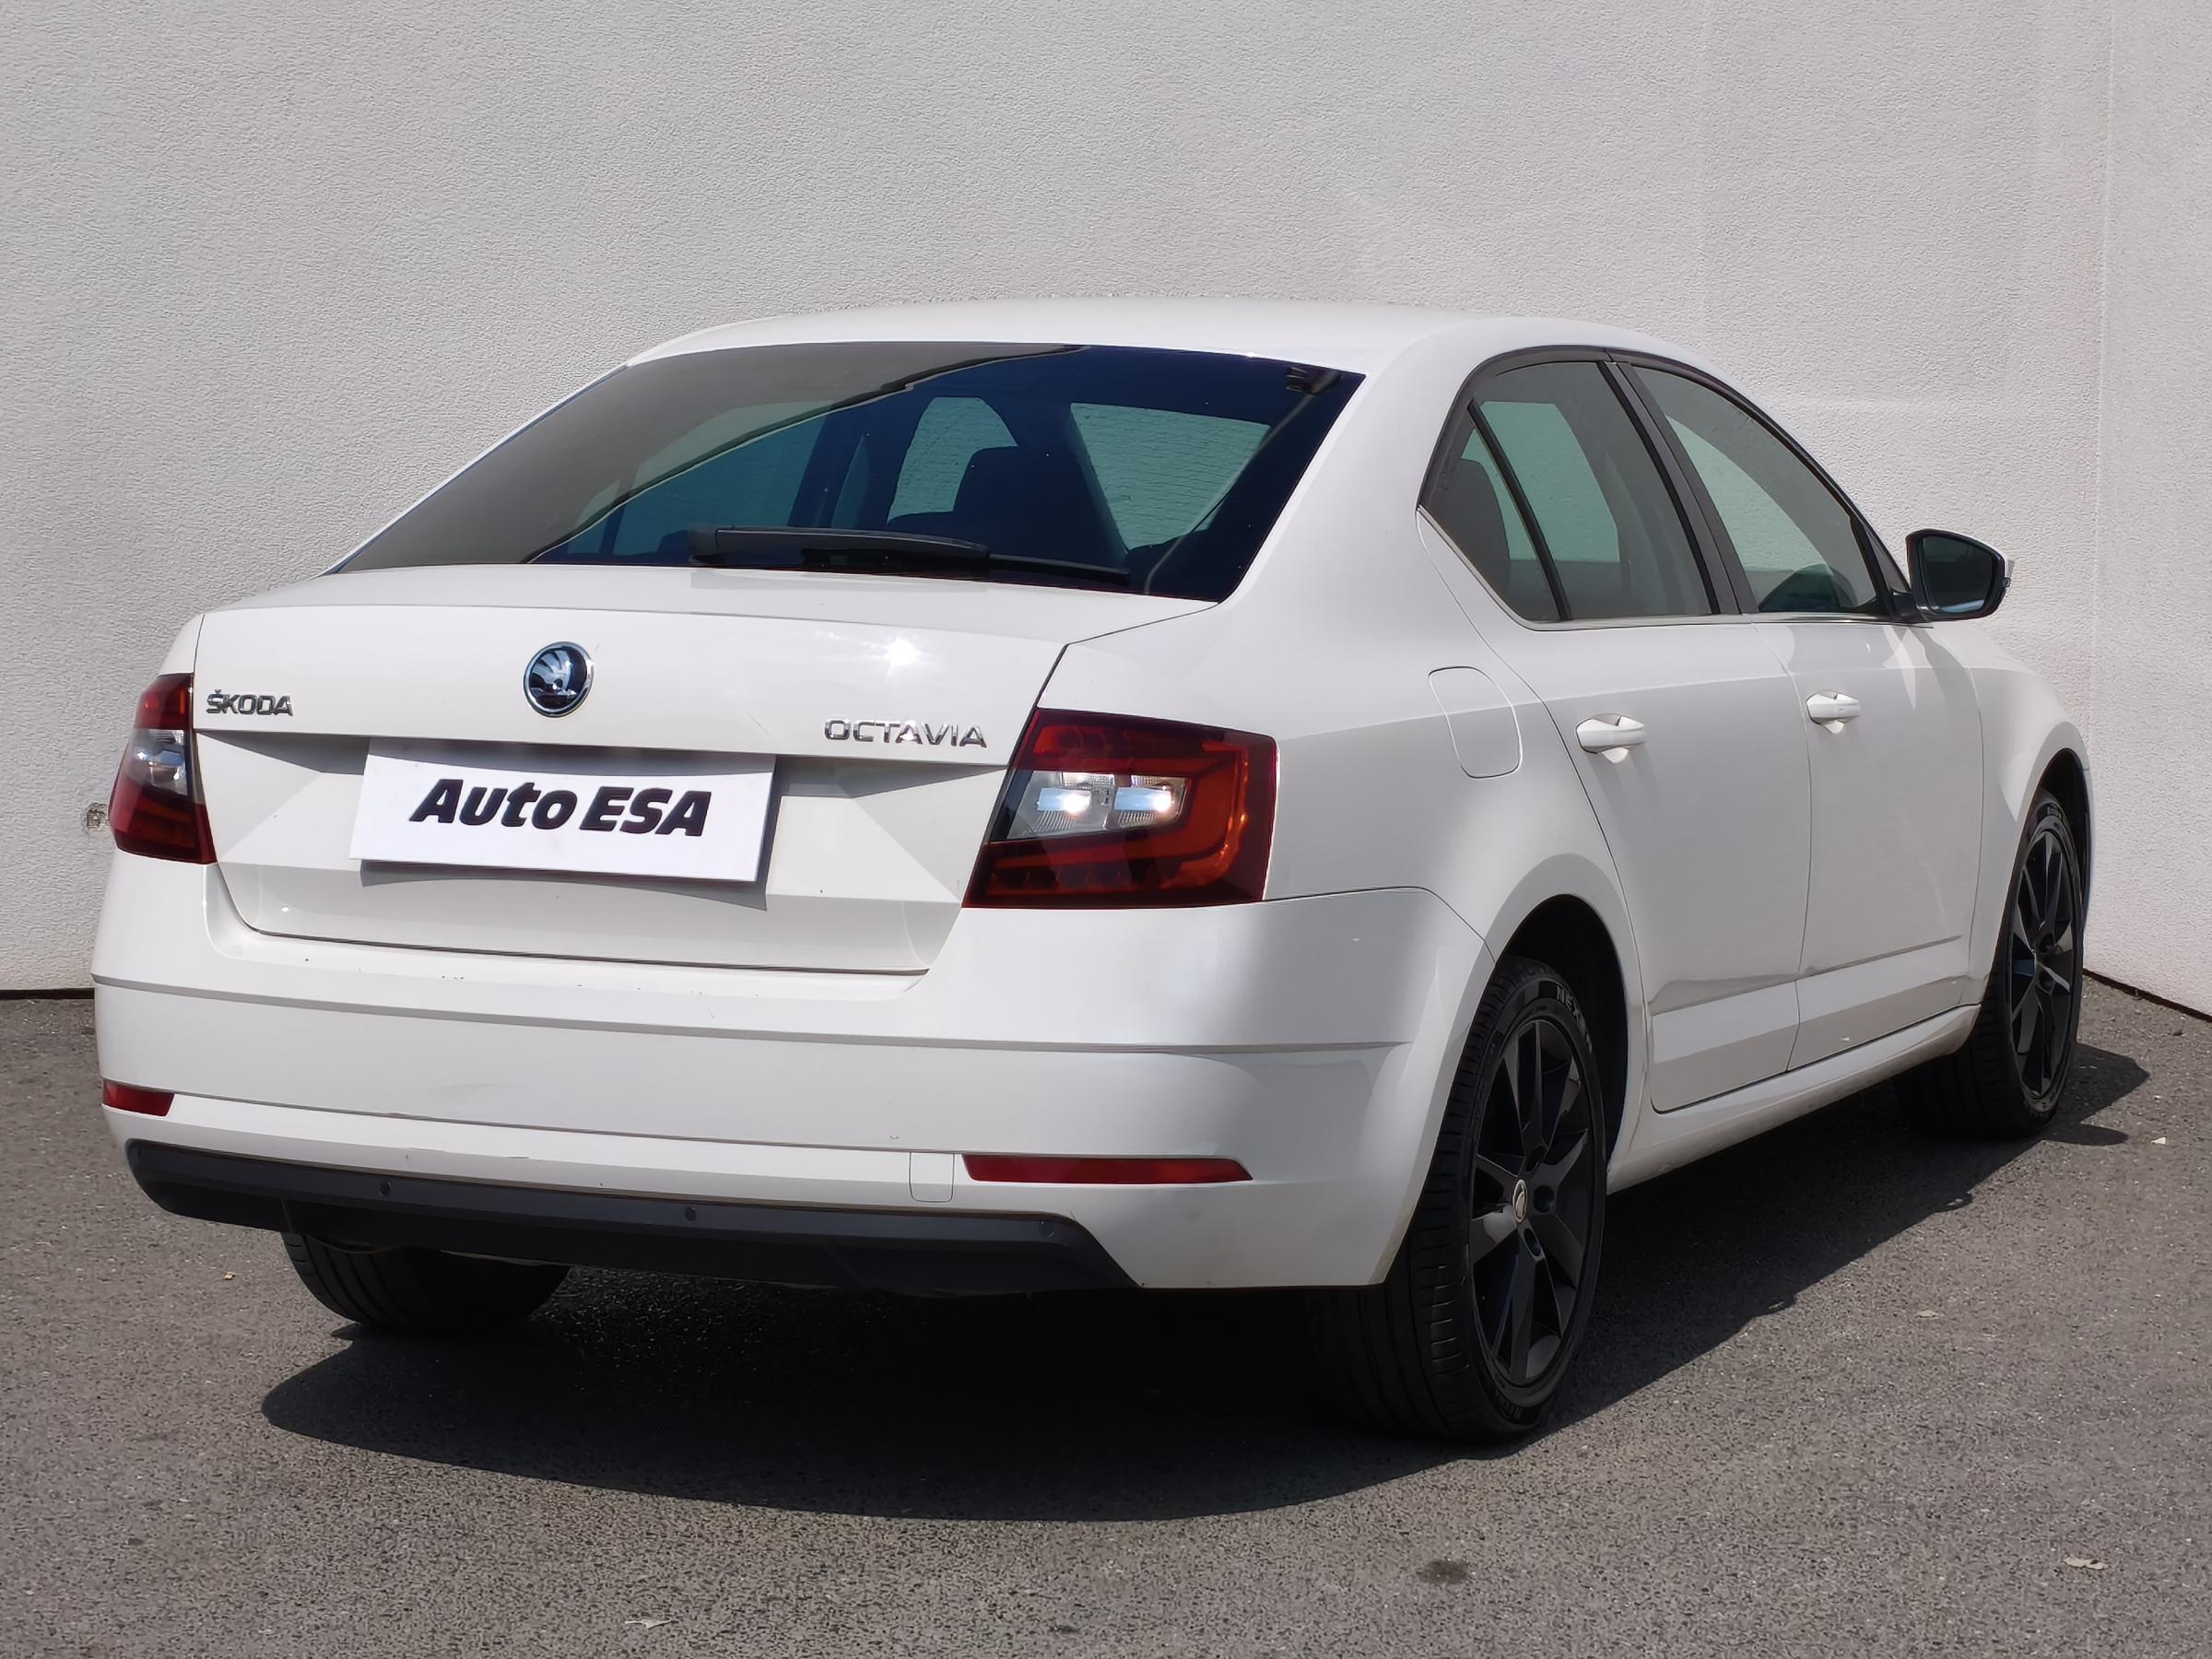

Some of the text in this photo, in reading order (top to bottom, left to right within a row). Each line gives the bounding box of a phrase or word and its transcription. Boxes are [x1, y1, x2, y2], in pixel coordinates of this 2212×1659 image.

[206, 688, 294, 717] ŠKODA
[824, 719, 988, 748] OCTAVIA
[408, 778, 712, 837] Auto ESA
